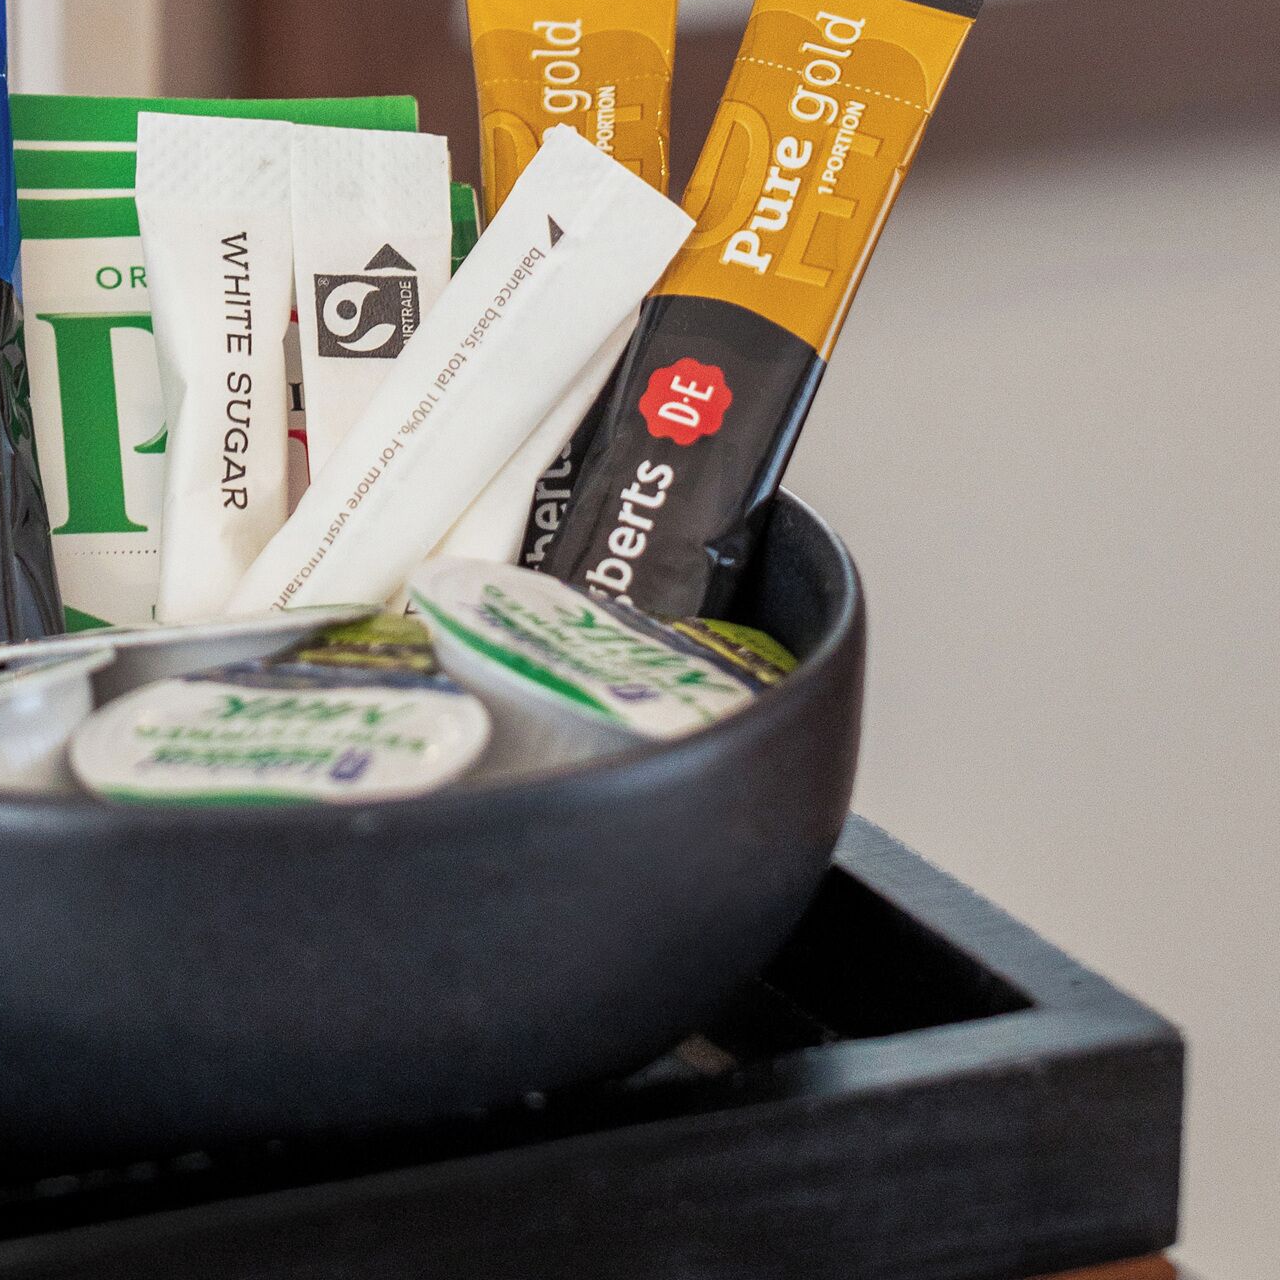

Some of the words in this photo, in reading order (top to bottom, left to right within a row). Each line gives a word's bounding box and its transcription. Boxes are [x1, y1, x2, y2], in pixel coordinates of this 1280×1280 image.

[531, 18, 593, 113] gold
[595, 85, 617, 153] PORTION
[720, 135, 813, 275] Pure
[789, 10, 866, 125] gold
[822, 100, 866, 185] PORTION
[818, 184, 833, 195] 1
[221, 232, 252, 356] WHITE
[494, 247, 547, 307] balance
[399, 281, 415, 345] IRTRADE
[461, 308, 502, 349] basis,
[434, 352, 468, 392] total
[221, 371, 252, 510] SUGAR
[346, 466, 380, 510] more
[586, 459, 675, 603] berts
